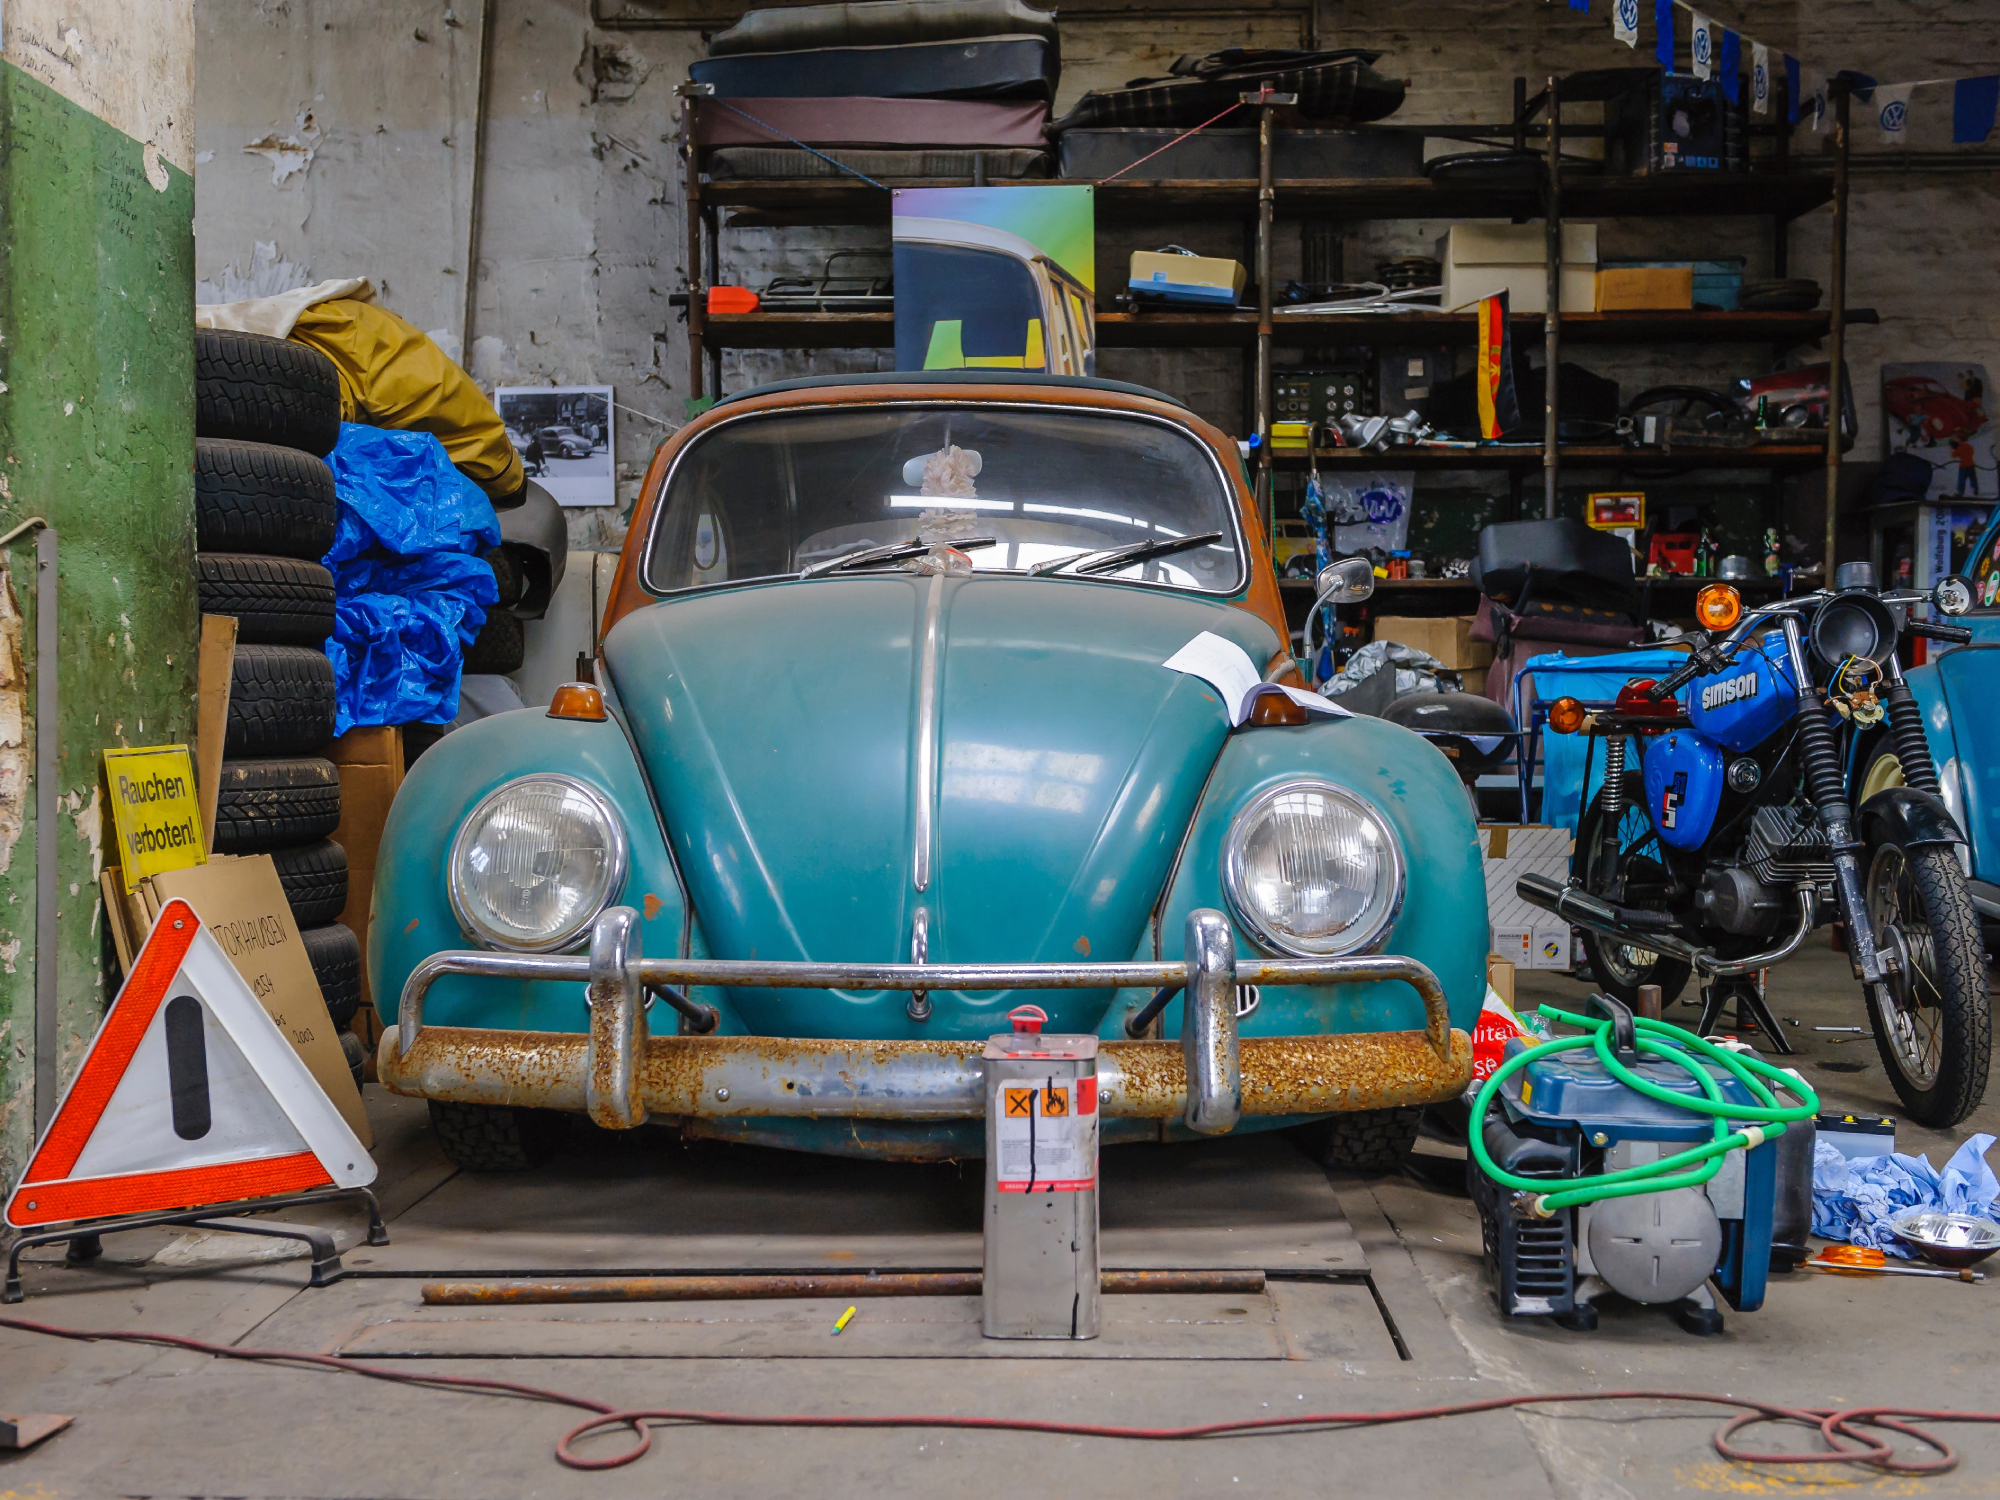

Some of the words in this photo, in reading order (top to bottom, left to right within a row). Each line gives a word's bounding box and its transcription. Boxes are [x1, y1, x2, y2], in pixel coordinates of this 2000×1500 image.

[1934, 529, 1948, 574] Wolfsburg
[118, 772, 187, 806] Rauchen
[126, 815, 197, 856] verboten!
[210, 914, 288, 956] TORHAUBEN
[270, 1009, 287, 1027] bis
[292, 1027, 315, 1045] 2003
[1473, 1021, 1514, 1045] lität
[1474, 1057, 1498, 1077] se
